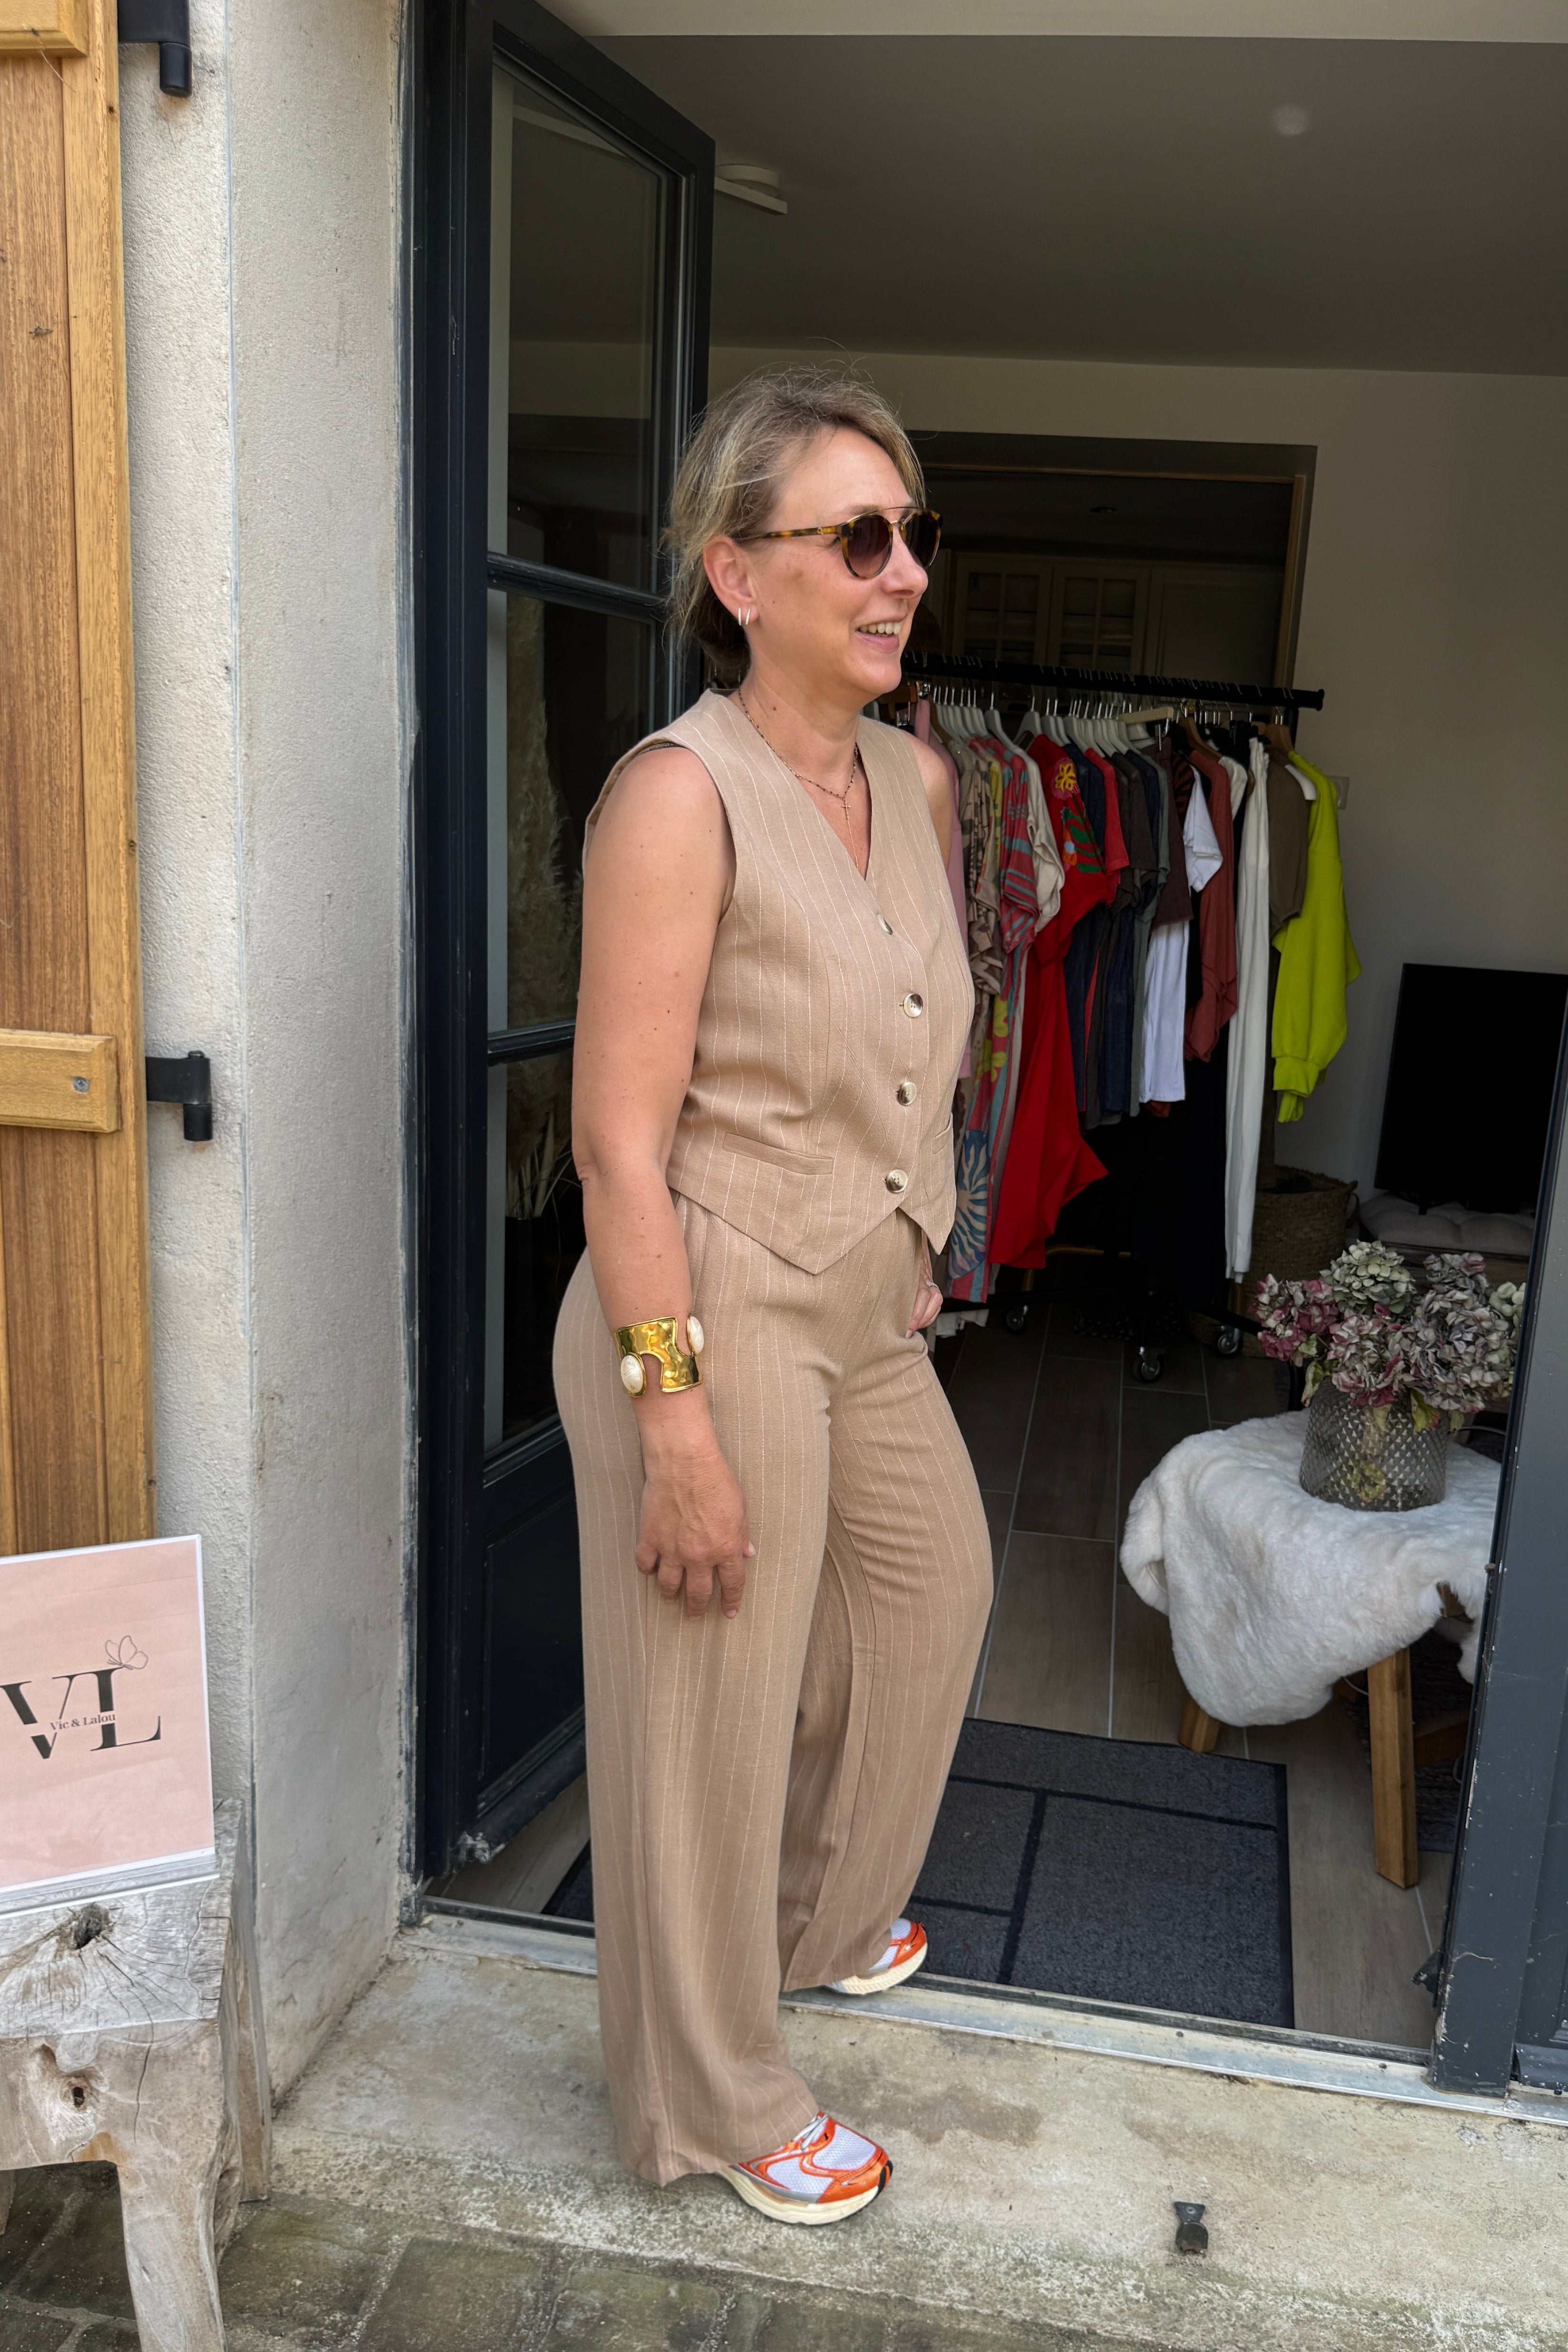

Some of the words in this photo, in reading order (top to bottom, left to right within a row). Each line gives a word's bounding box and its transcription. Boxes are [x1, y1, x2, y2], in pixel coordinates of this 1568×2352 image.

[0, 1666, 161, 1759] VL
[50, 1721, 69, 1730] Vic
[71, 1719, 80, 1727] &
[83, 1714, 116, 1725] Lalou
